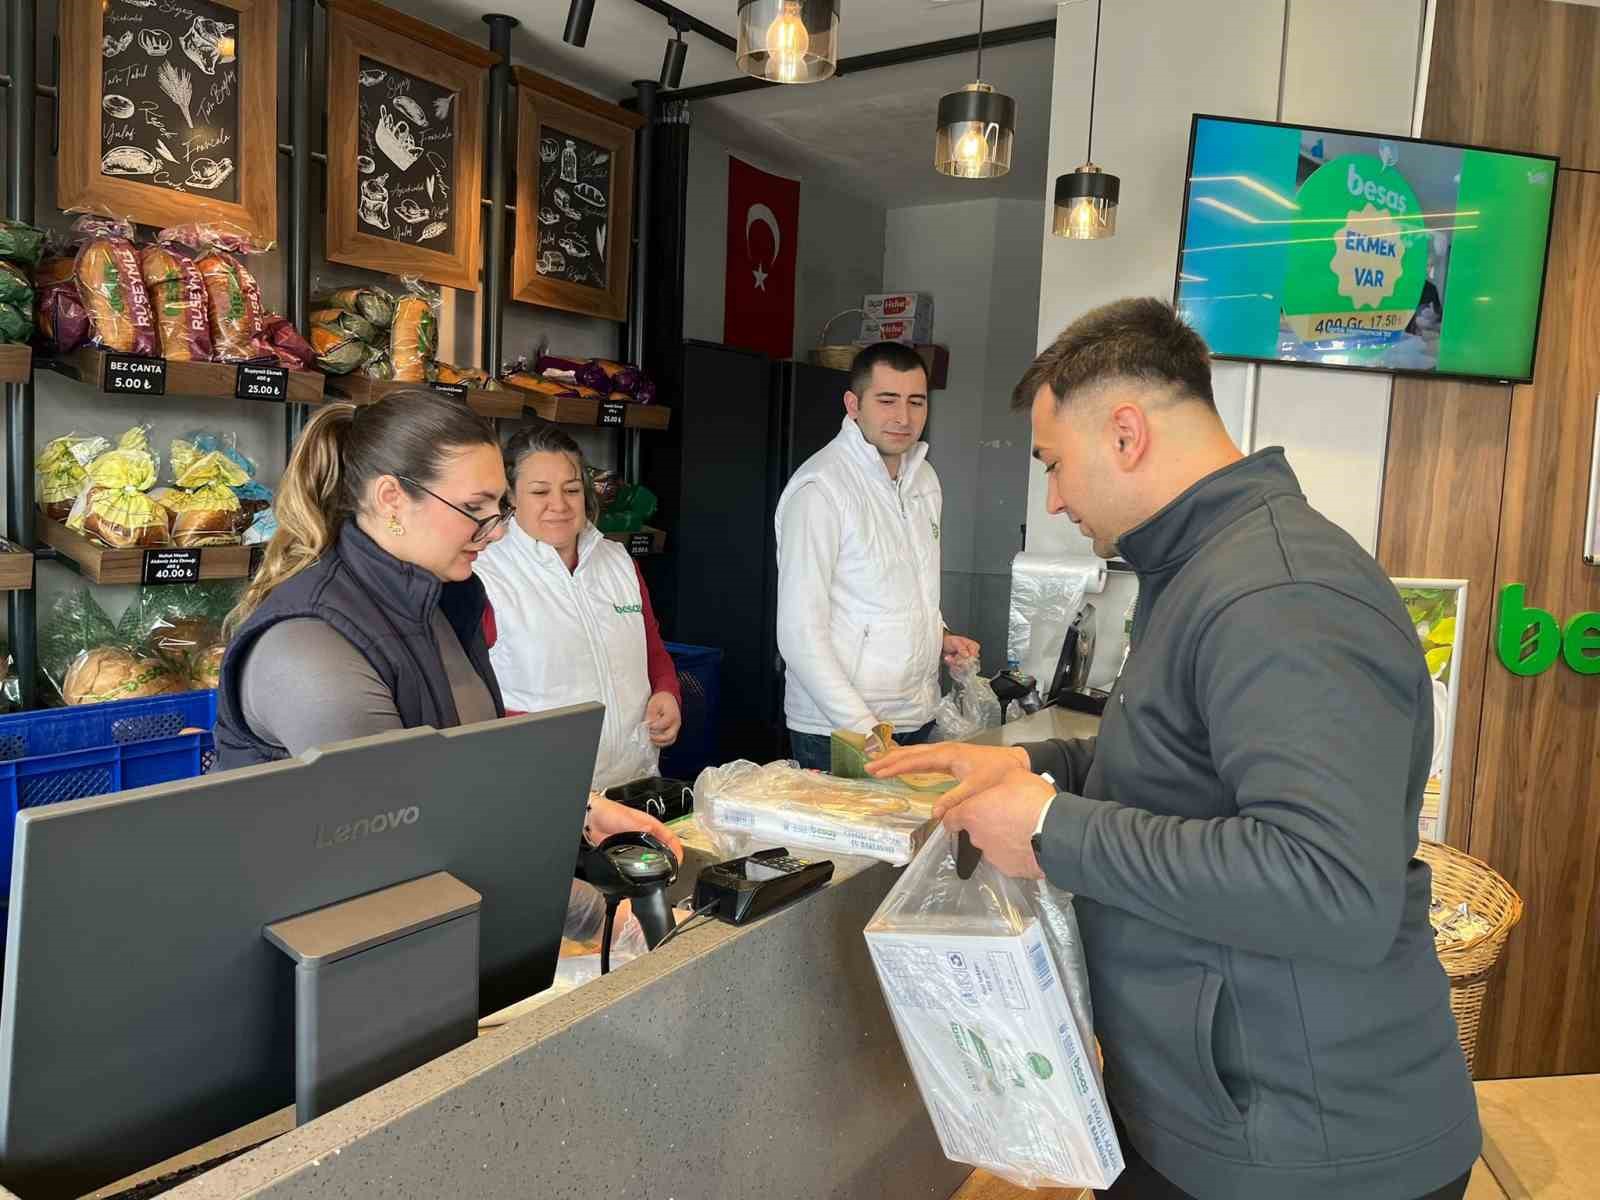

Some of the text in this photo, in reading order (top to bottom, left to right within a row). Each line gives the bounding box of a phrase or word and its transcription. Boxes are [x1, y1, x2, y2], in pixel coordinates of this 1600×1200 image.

[1345, 230, 1397, 258] EKMEK
[1354, 267, 1385, 289] VAR
[110, 361, 162, 374] BEZ ÇANTA
[114, 377, 142, 389] 5.00
[248, 384, 273, 395] 25.00
[156, 569, 184, 578] 40.00
[313, 805, 420, 849] Lenovo
